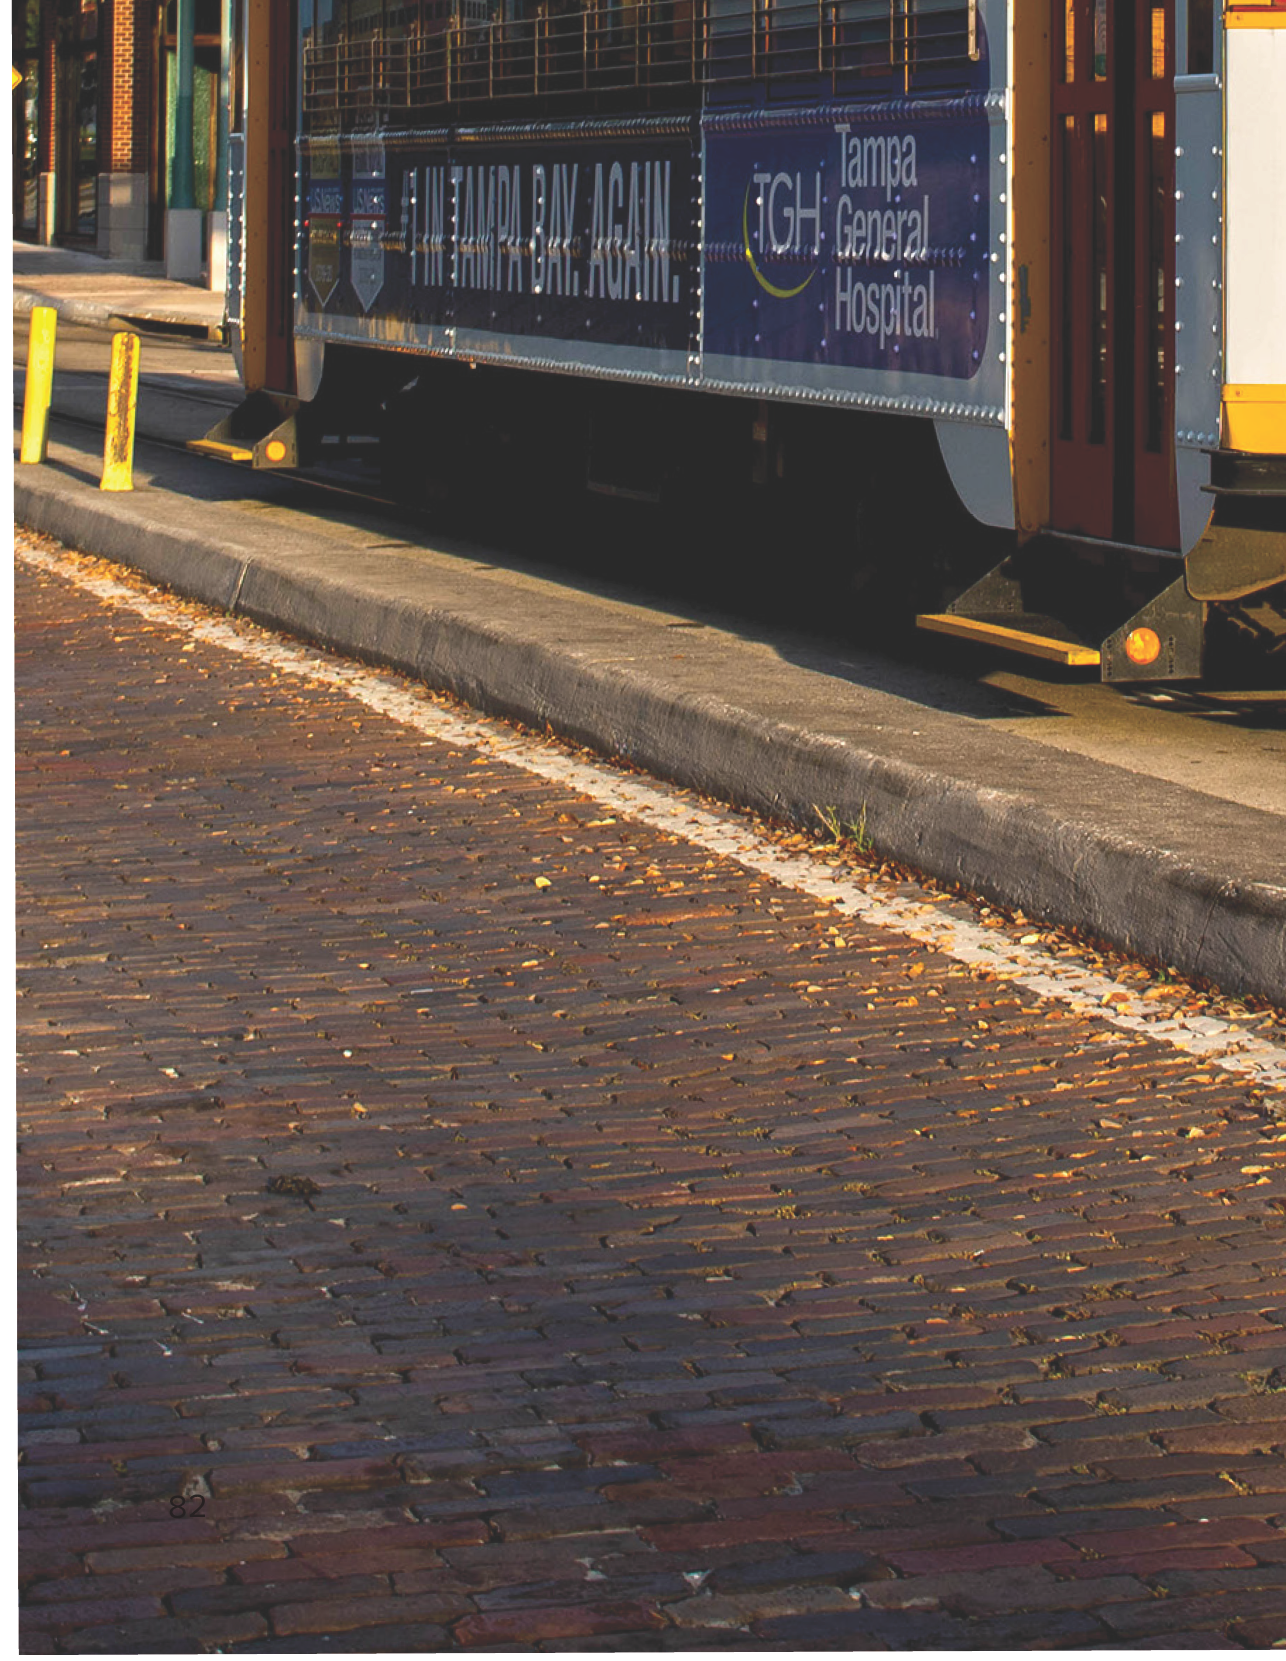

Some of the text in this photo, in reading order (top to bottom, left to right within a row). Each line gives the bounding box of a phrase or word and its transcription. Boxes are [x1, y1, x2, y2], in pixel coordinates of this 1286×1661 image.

[834, 123, 918, 203] Tampa
[424, 165, 445, 287] IN
[451, 165, 523, 293] TAMPA
[531, 163, 580, 297] BAY.
[588, 160, 680, 304] AGAIN.
[753, 170, 822, 256] TGH
[835, 193, 930, 261] General
[834, 265, 935, 350] Hospital
